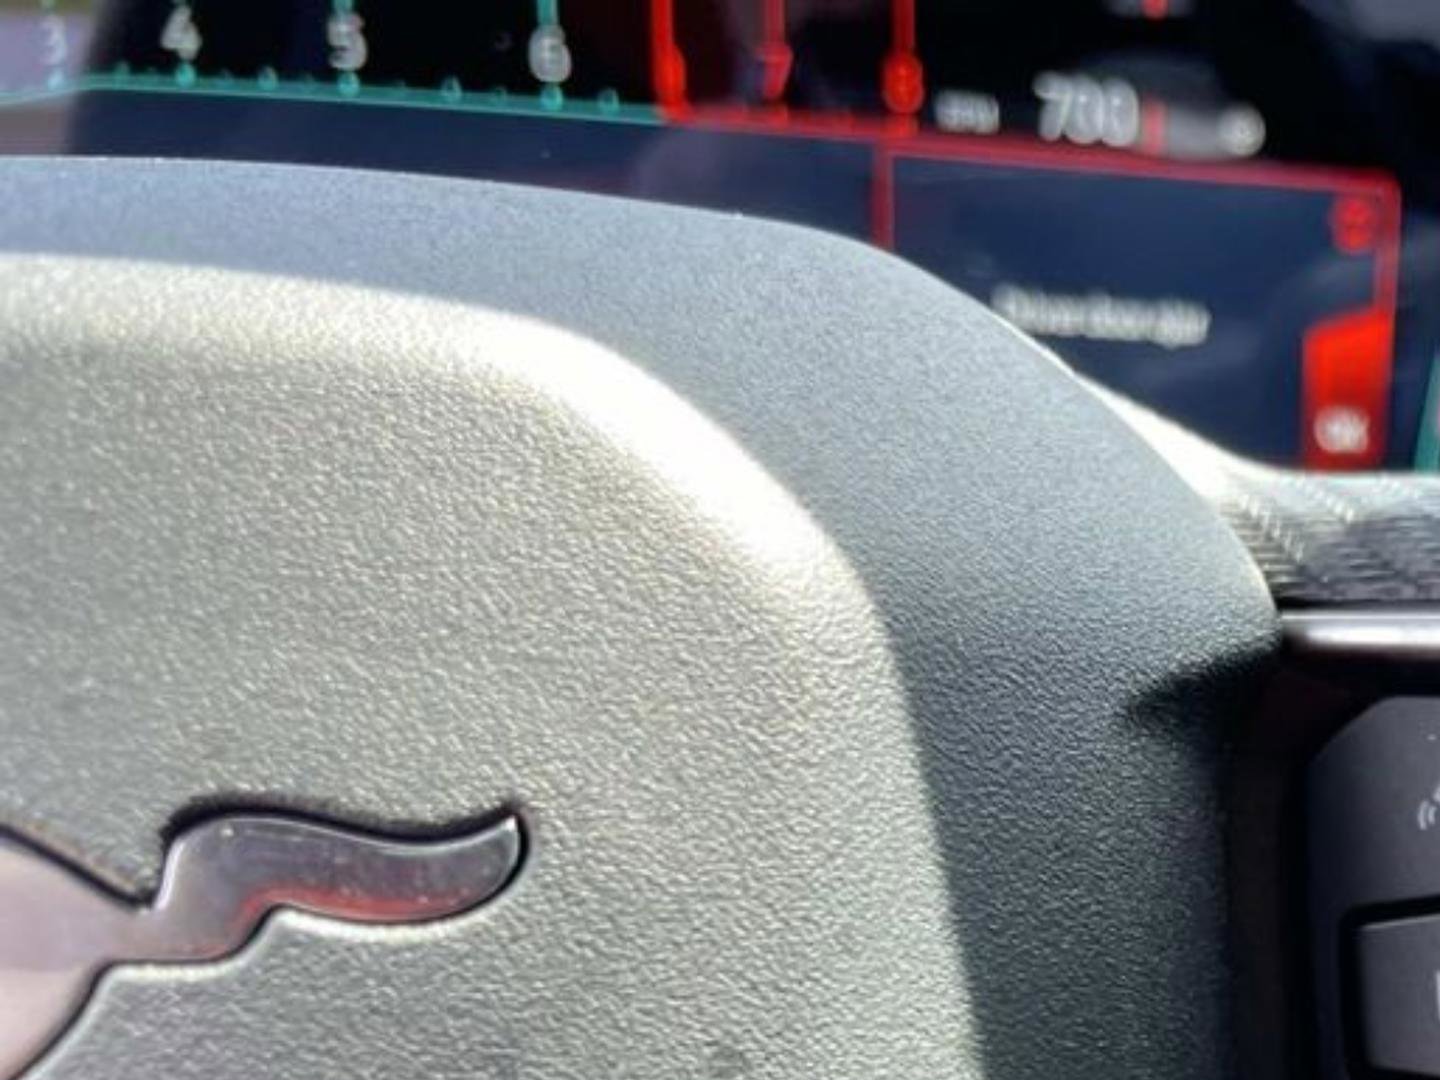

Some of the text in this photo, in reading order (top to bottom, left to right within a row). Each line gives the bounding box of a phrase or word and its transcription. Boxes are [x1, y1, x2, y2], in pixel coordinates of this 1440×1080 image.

[160, 4, 202, 60] 4
[327, 12, 368, 71] 5
[528, 23, 572, 83] 6
[754, 44, 794, 99] 7
